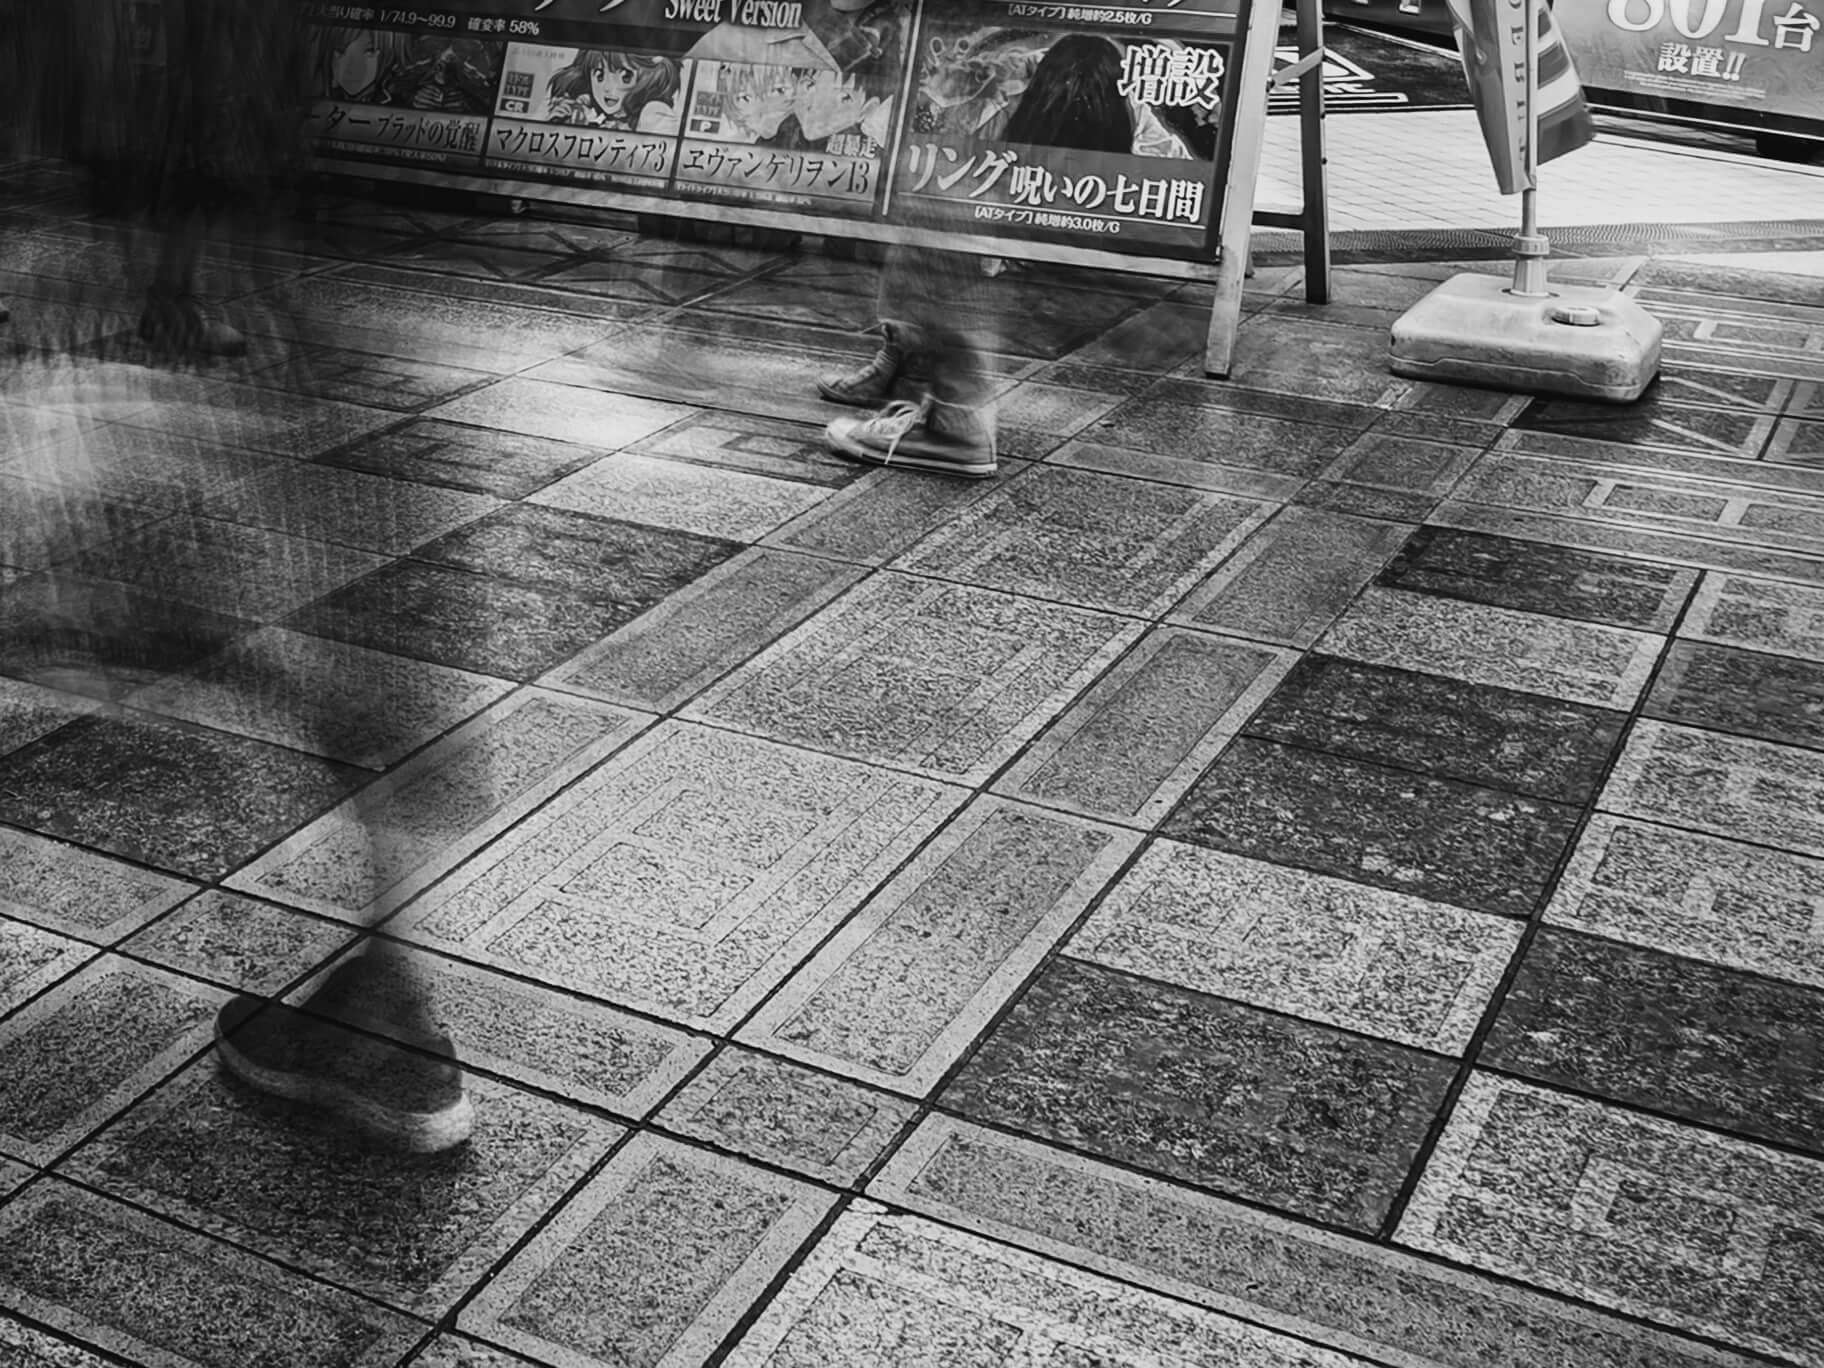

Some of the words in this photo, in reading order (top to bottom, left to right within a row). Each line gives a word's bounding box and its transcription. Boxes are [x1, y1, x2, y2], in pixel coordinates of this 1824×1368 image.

[508, 18, 541, 36] 58%
[1116, 42, 1225, 110] 増設
[1656, 41, 1747, 82] 設置!!
[504, 101, 524, 112] CR
[495, 124, 668, 173] マクロスフロンティア3
[904, 143, 1018, 200] リング
[1008, 163, 1206, 224] 呪いの七日間
